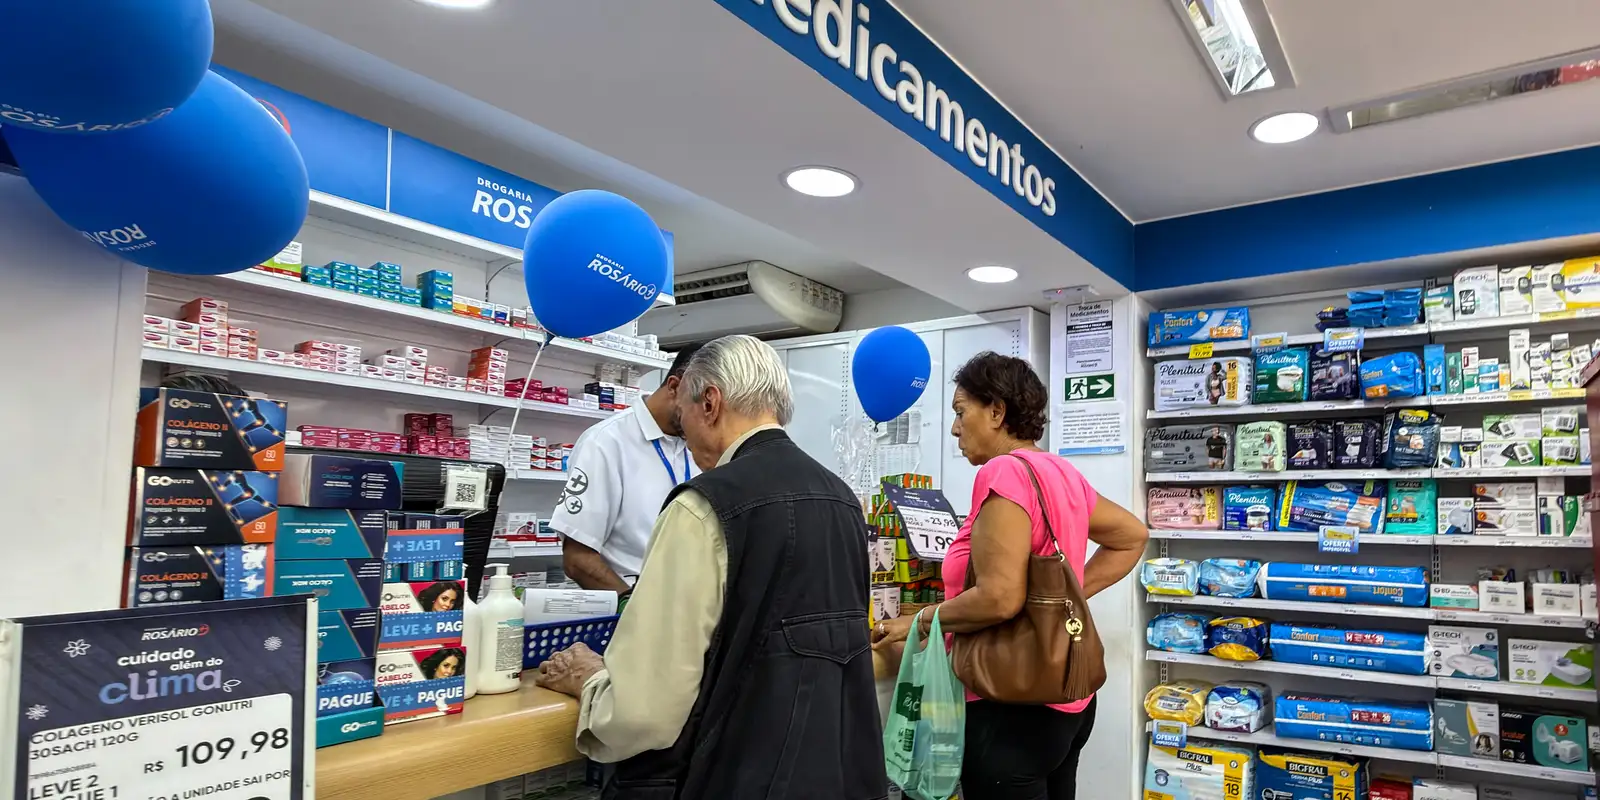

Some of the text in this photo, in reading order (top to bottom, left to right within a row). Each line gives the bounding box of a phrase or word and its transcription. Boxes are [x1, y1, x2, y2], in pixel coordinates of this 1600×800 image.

[752, 0, 1057, 217] edicamentos
[477, 176, 533, 204] DROGARIA
[471, 189, 533, 229] ROS
[595, 253, 624, 270] DROGARIA
[587, 258, 648, 297] ROSÁRIO
[1070, 308, 1110, 318] Medicamentos
[1260, 354, 1300, 364] Plenitud
[1160, 363, 1206, 377] Plenitud
[167, 419, 221, 431] COLÁGENO
[1150, 427, 1207, 442] Plenitud
[265, 449, 277, 459] 60
[147, 475, 194, 487] GONUTRI
[145, 496, 204, 506] COLÁGENO
[1150, 489, 1188, 500] Plenitud
[1228, 493, 1268, 504] Plenitud
[255, 521, 266, 530] 60
[407, 539, 441, 552] LEVE
[140, 572, 199, 582] COLÁGENO
[1372, 586, 1404, 597] Confort
[141, 627, 199, 641] ROSÁRIO
[384, 624, 419, 637] LEVE
[436, 620, 463, 633] PAG
[1433, 631, 1462, 639] G-TECH
[1291, 631, 1319, 642] Confort
[117, 647, 195, 667] cuidado
[170, 657, 224, 671] além do
[377, 672, 413, 683] CABELOS
[99, 669, 222, 705] clima
[318, 691, 374, 711] PAGUE
[417, 686, 463, 704] PAGUE
[30, 699, 253, 745] COLAGENO VERISOL GONUTRI
[1297, 710, 1326, 721] Confort
[1155, 733, 1180, 742] OFERTA
[30, 732, 139, 761] 30SACH 120G
[1179, 751, 1210, 764] BIGFRAL
[144, 760, 164, 775] R$
[1185, 762, 1202, 773] plus
[1288, 762, 1325, 775] BIGFRAL
[183, 780, 241, 799] UNIDADE
[243, 775, 262, 787] SAI
[265, 770, 291, 782] POR
[1308, 775, 1324, 785] plus
[30, 774, 99, 800] LEVE 2
[1225, 782, 1240, 796] 18
